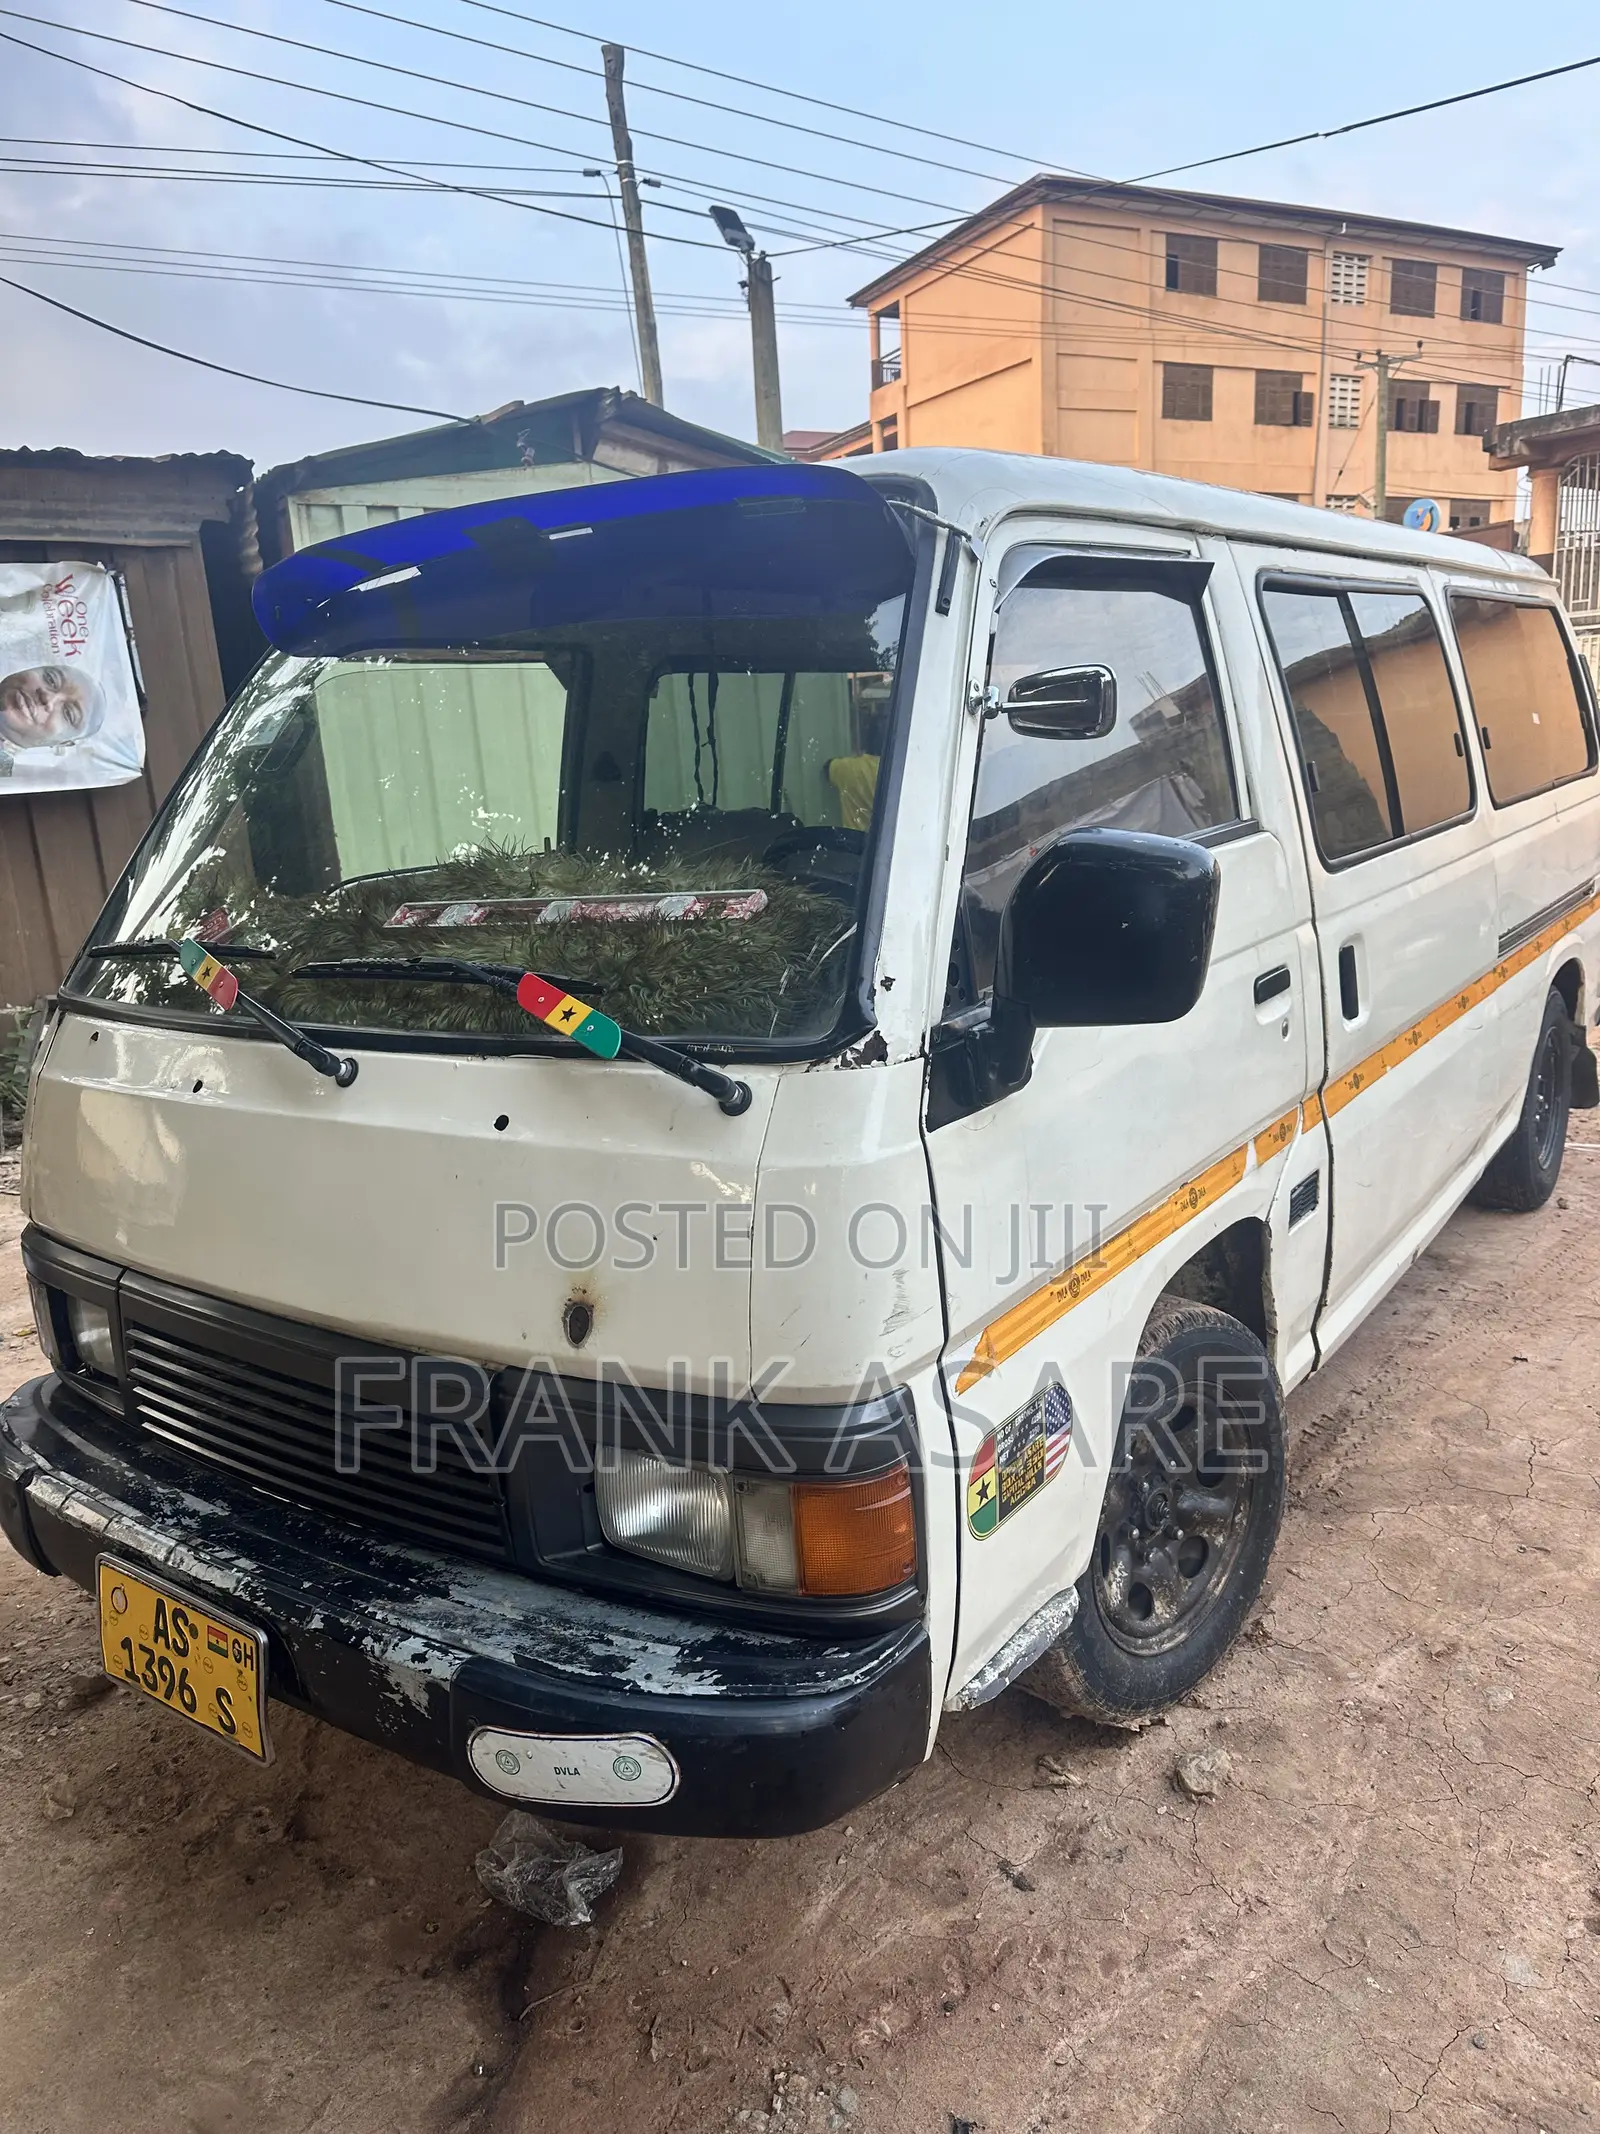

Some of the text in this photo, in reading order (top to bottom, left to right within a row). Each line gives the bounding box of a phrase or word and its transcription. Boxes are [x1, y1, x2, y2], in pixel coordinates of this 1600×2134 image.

[55, 574, 86, 657] Week
[76, 601, 89, 637] one
[997, 1434, 1014, 1453] GROSS
[999, 1450, 1009, 1465] NET
[1010, 1477, 1036, 1505] ACCRA
[153, 1597, 254, 1671] AS GH
[120, 1636, 237, 1735] 1396 S
[553, 1765, 581, 1777] DVLA
